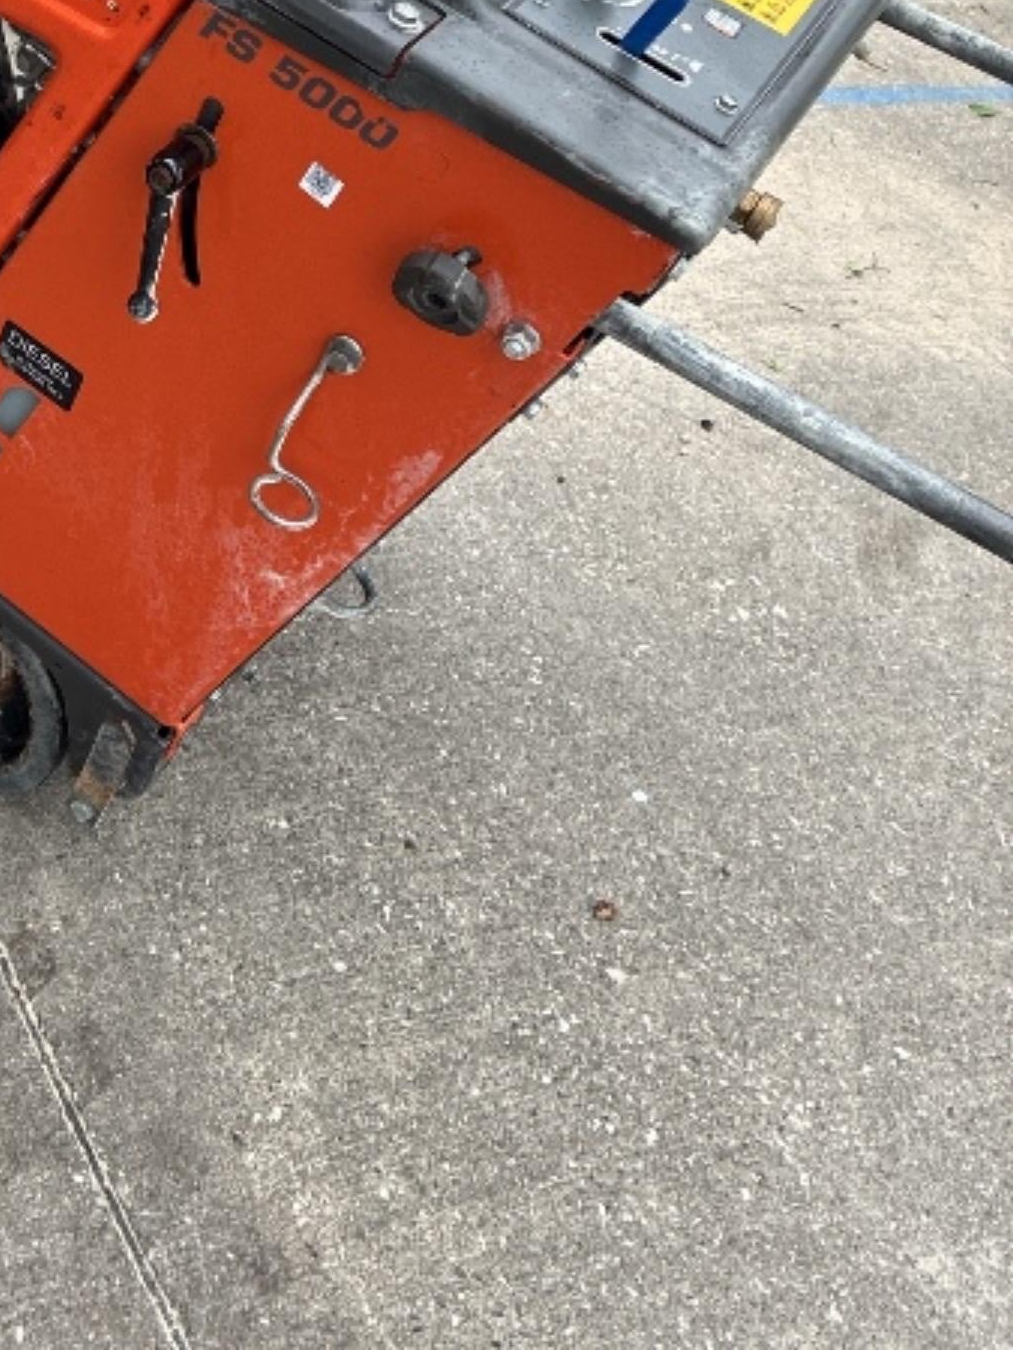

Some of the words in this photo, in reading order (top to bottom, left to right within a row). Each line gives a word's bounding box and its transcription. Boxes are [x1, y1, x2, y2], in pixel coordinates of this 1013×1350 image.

[198, 10, 264, 64] FS
[268, 55, 400, 151] 5000
[7, 328, 73, 389] DIESEL
